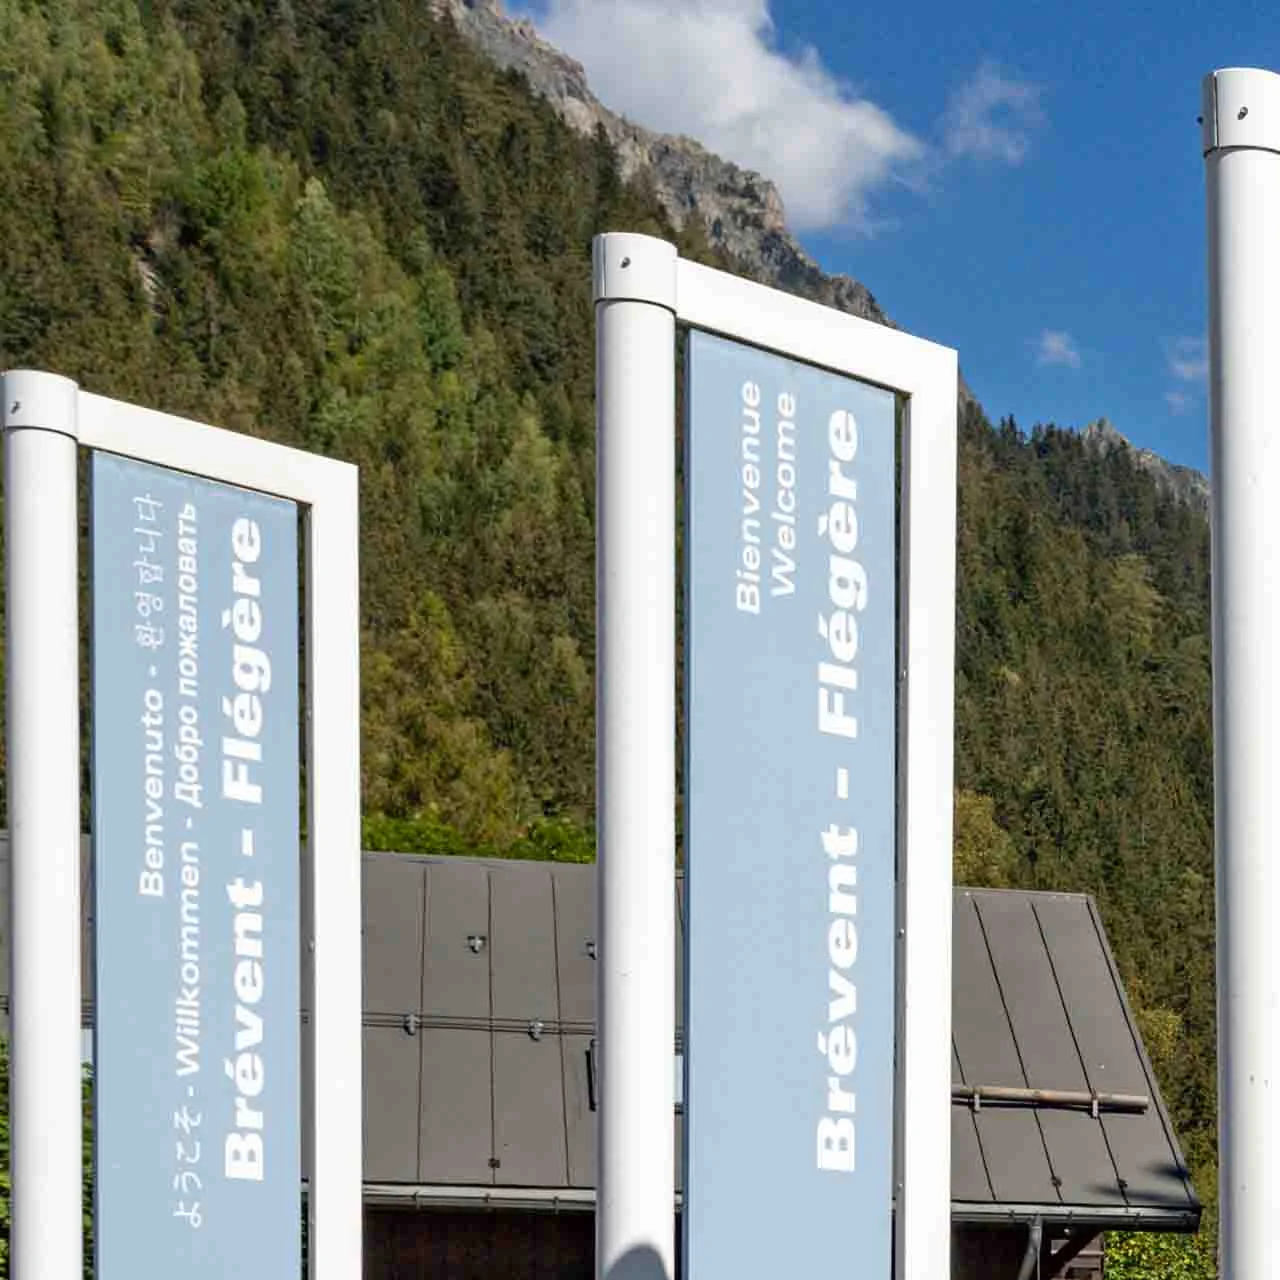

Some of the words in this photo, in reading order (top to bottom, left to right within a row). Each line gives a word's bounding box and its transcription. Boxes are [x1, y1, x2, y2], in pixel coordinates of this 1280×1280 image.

[132, 493, 165, 651] 환영합니다
[177, 502, 199, 697] пожаловать
[735, 380, 761, 616] Bienvenue
[769, 391, 797, 597] Welcome
[817, 409, 869, 739] Flégère
[173, 704, 204, 809] Добро
[221, 517, 273, 805] Flégère
[137, 687, 166, 899] Benvenuto
[173, 841, 202, 1077] Willkommen
[222, 876, 265, 1182] Brévent
[815, 823, 859, 1173] Brévent
[172, 1105, 203, 1229] ようこそ
